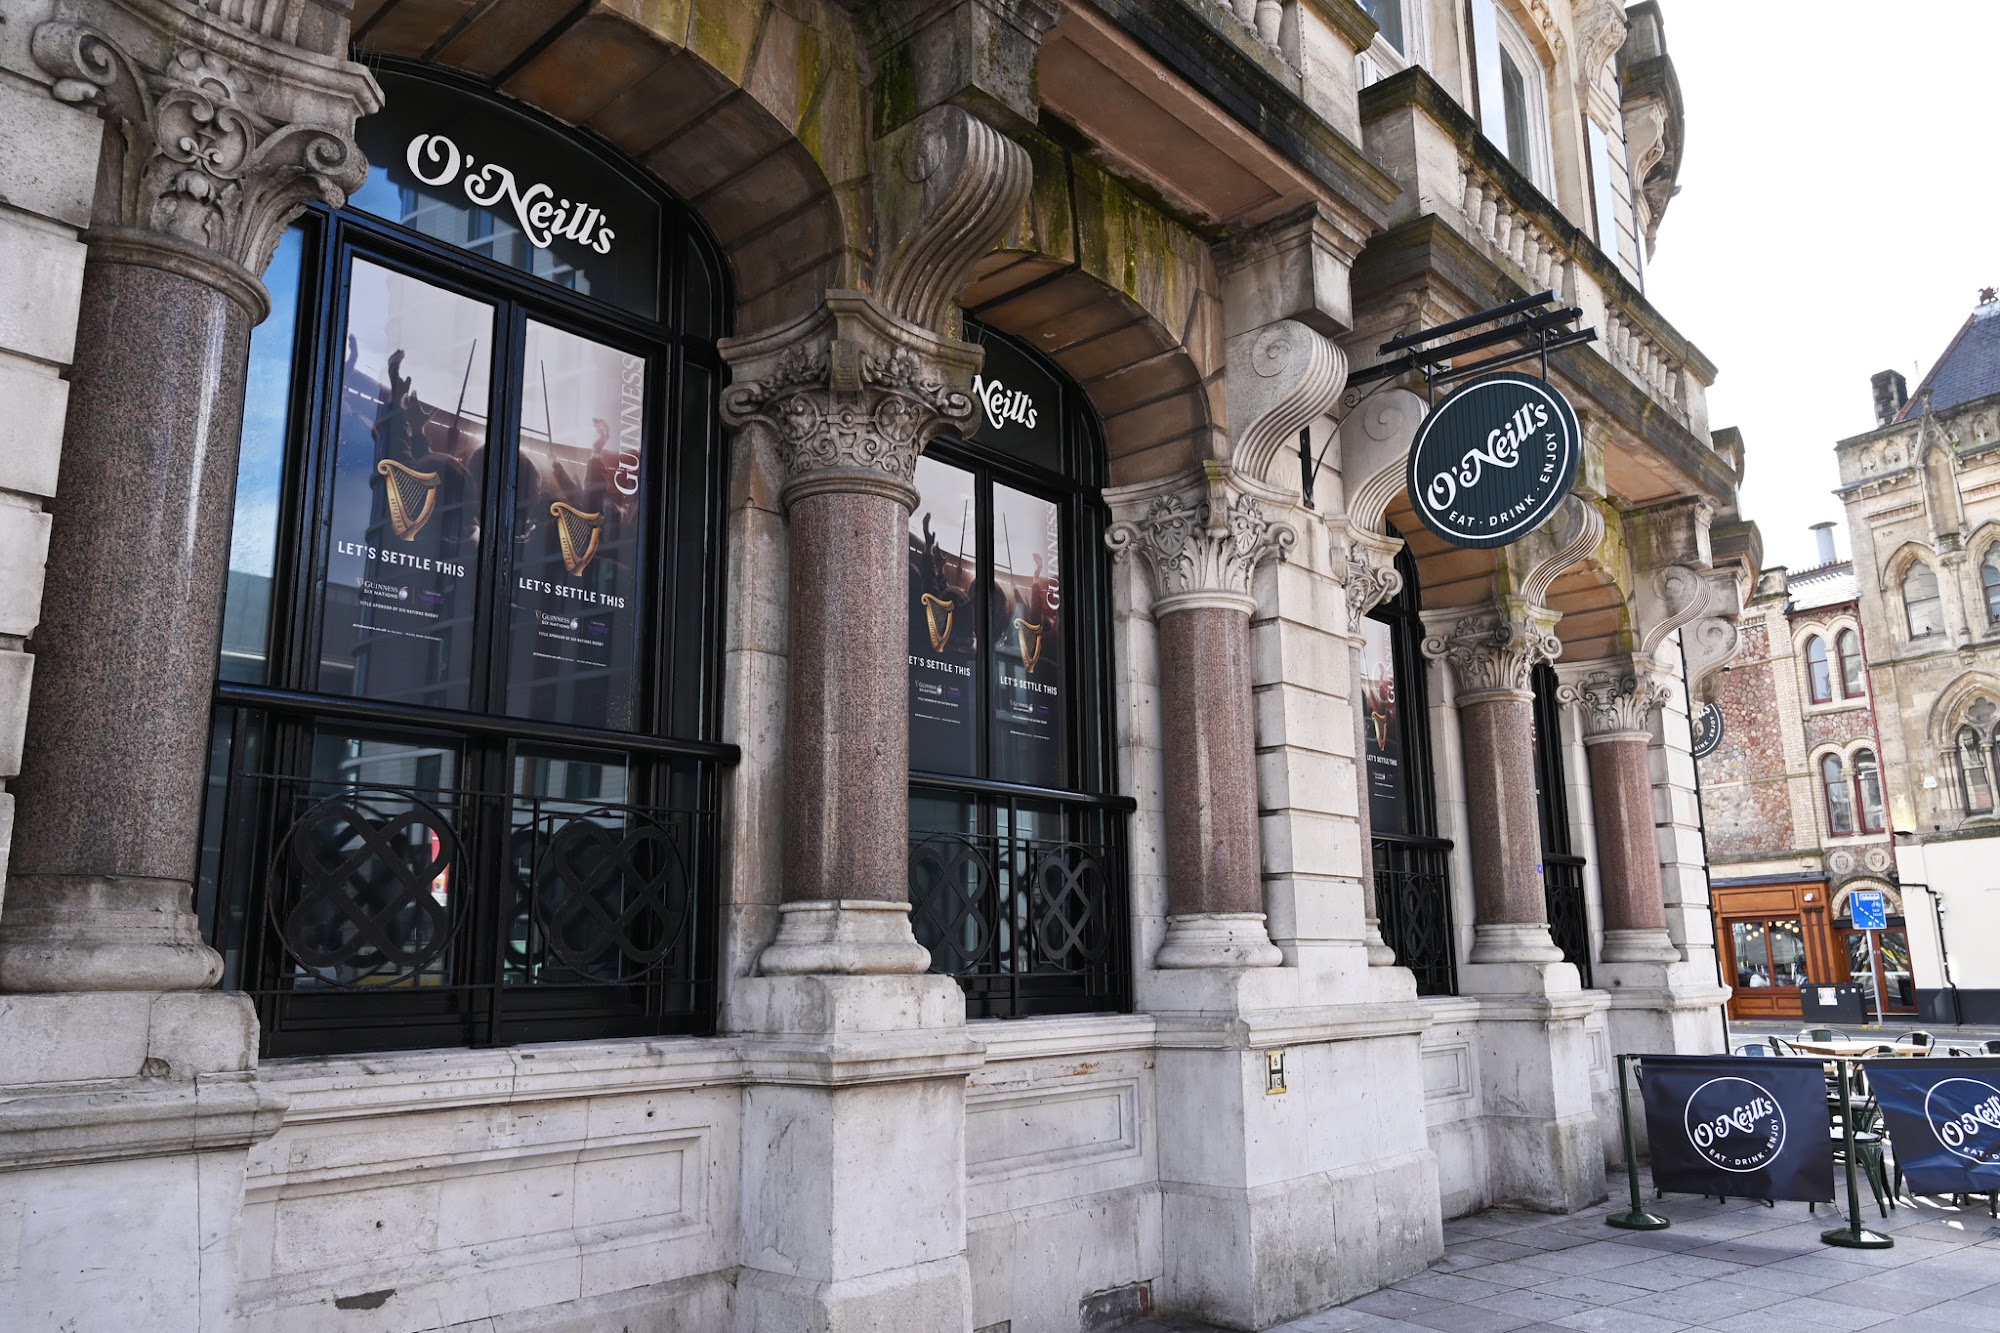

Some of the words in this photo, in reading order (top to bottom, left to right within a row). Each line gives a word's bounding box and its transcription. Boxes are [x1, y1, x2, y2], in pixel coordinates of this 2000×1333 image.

[406, 134, 616, 254] O'Neill's
[614, 356, 645, 496] GUINNESS
[972, 374, 1038, 430] Neill's
[1427, 402, 1548, 511] O'Neill's
[1448, 510, 1475, 527] EAT
[1489, 493, 1536, 527] DRINK
[1539, 432, 1558, 484] ENJOY
[338, 541, 377, 560] LET'S
[381, 549, 431, 571] SETTLE
[435, 560, 465, 578] THIS
[1046, 504, 1060, 610] GUINNESS
[364, 580, 398, 593] GUINNESS
[373, 590, 398, 600] NATIONS
[519, 577, 551, 594] LET'S
[555, 584, 597, 603] SETTLE
[600, 593, 625, 609] THIS
[541, 612, 570, 623] GUINNESS
[909, 655, 925, 667] ET'S
[926, 659, 953, 673] SETTLE
[954, 665, 971, 677] THIS
[1000, 675, 1018, 688] LET'S
[1019, 679, 1042, 693] SETTLE
[1043, 684, 1058, 696] THIS
[1694, 1097, 1773, 1148] O'Neill's
[1708, 1148, 1727, 1162] EAT
[1735, 1151, 1765, 1166] DRINK
[1766, 1118, 1779, 1149] ENJOY
[1941, 1095, 2000, 1147] O'Neill'
[1963, 1146, 1985, 1157] EAT
